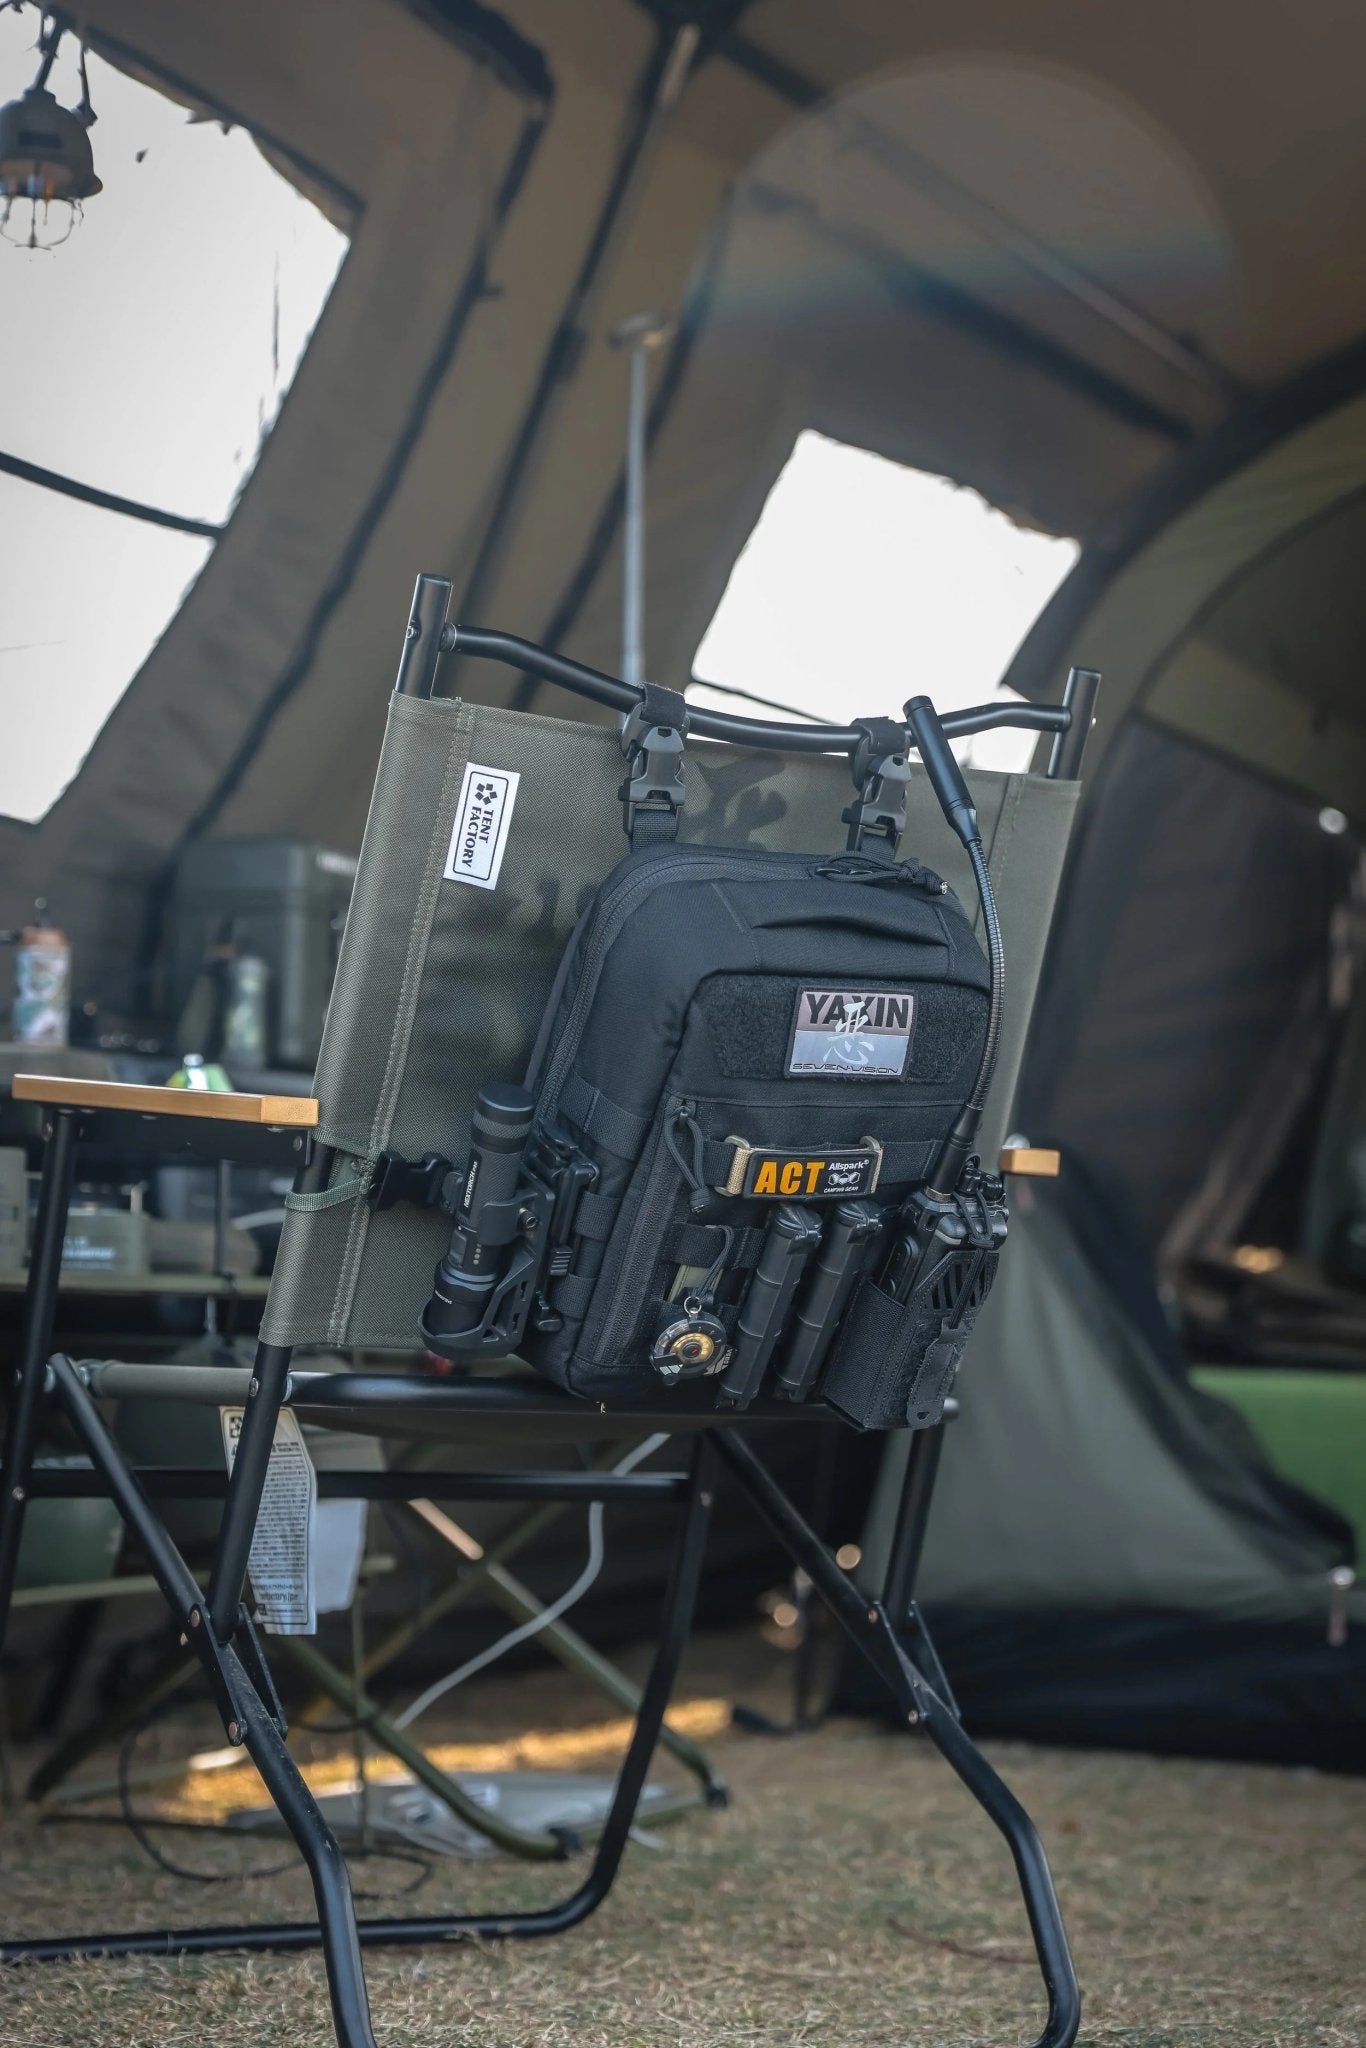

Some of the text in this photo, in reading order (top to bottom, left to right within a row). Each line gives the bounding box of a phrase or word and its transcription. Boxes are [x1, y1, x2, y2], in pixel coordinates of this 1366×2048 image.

[461, 806, 482, 868] FACTORY
[478, 809, 494, 843] TENT
[806, 993, 909, 1029] YAXIN
[464, 1171, 475, 1208] NEXTORCH
[753, 1161, 826, 1195] ACT
